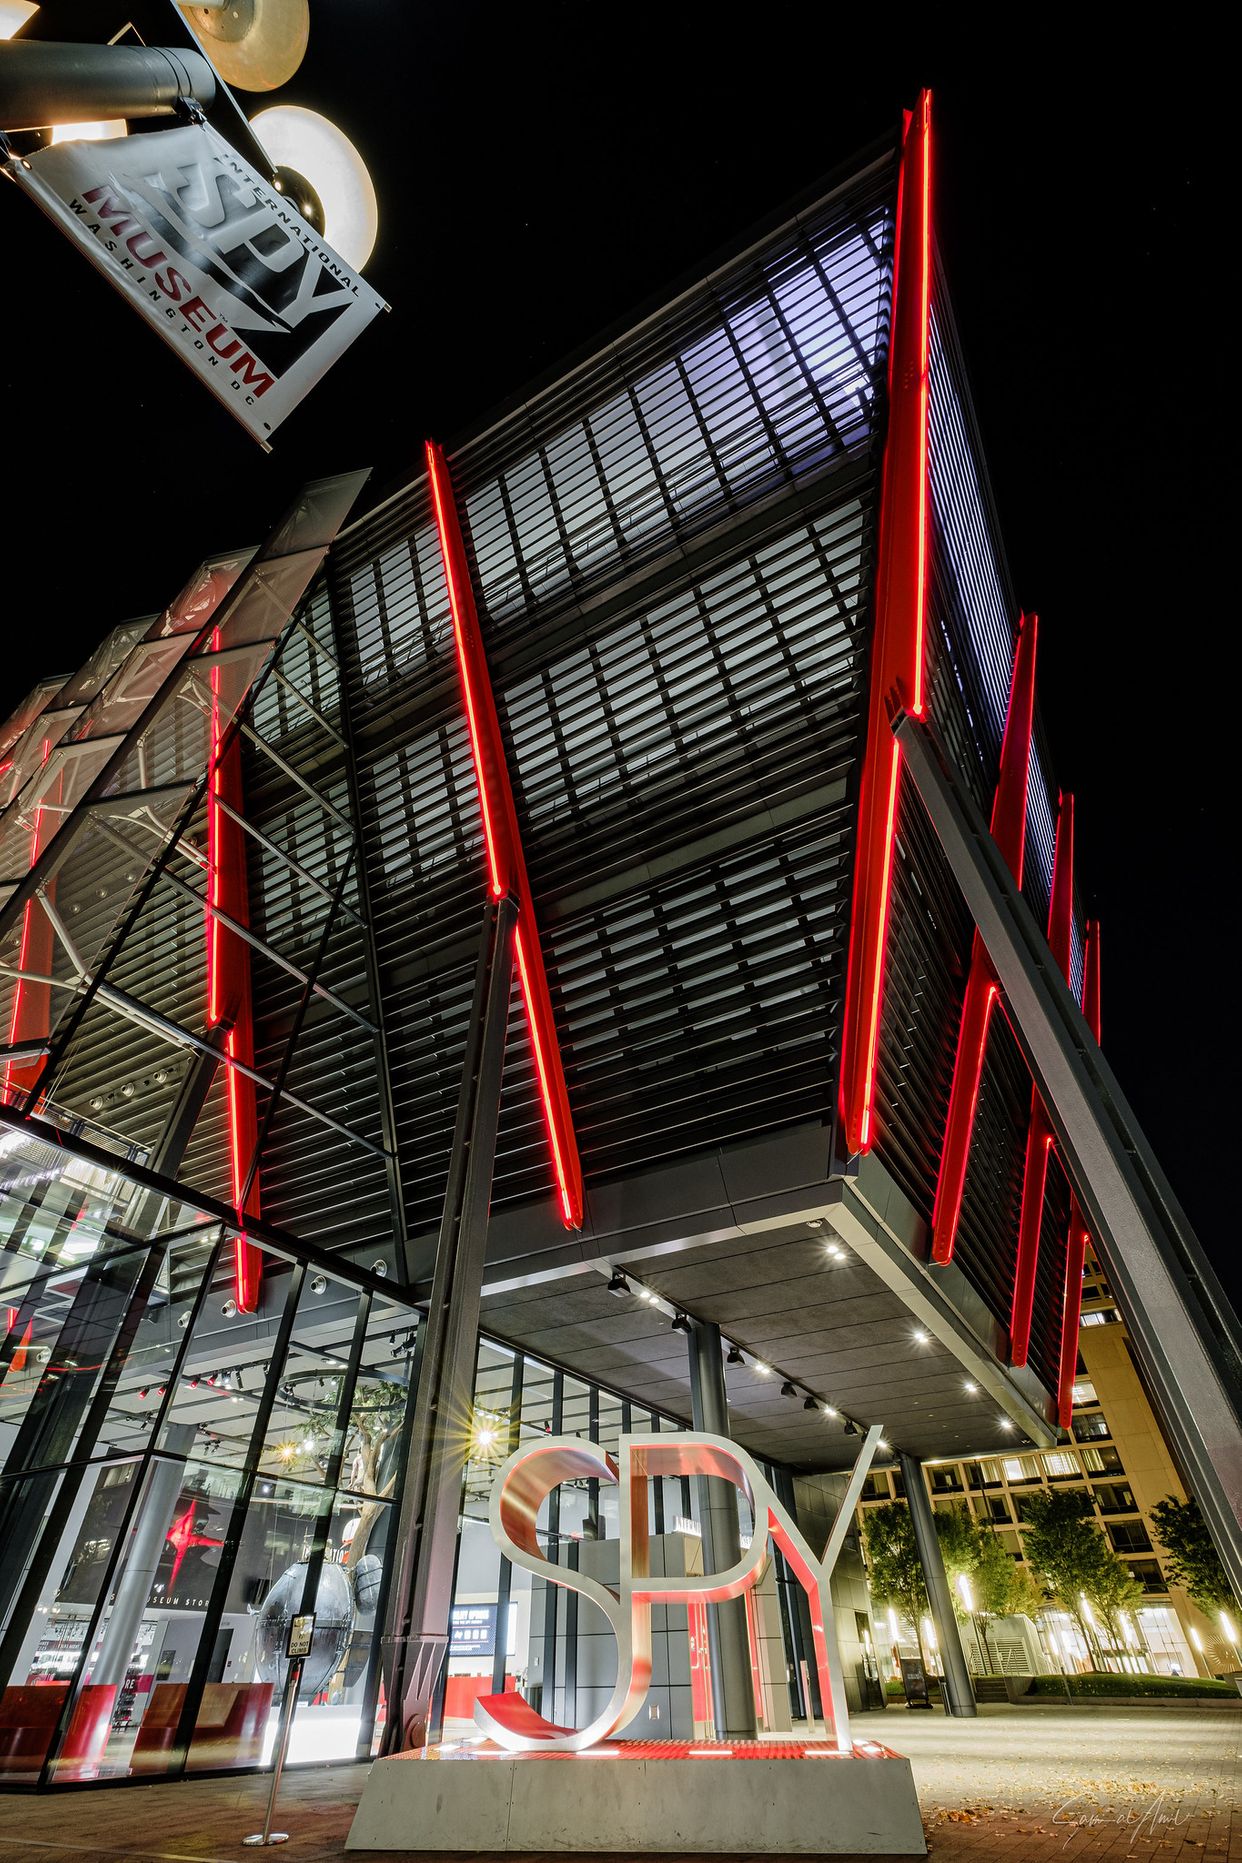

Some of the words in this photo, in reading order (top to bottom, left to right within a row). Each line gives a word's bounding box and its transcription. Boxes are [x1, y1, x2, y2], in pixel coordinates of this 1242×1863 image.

[68, 198, 219, 367] WASHINGTON
[81, 184, 276, 399] MUSEUM
[185, 1598, 210, 1607] STOR
[473, 1424, 884, 1754] SPY
